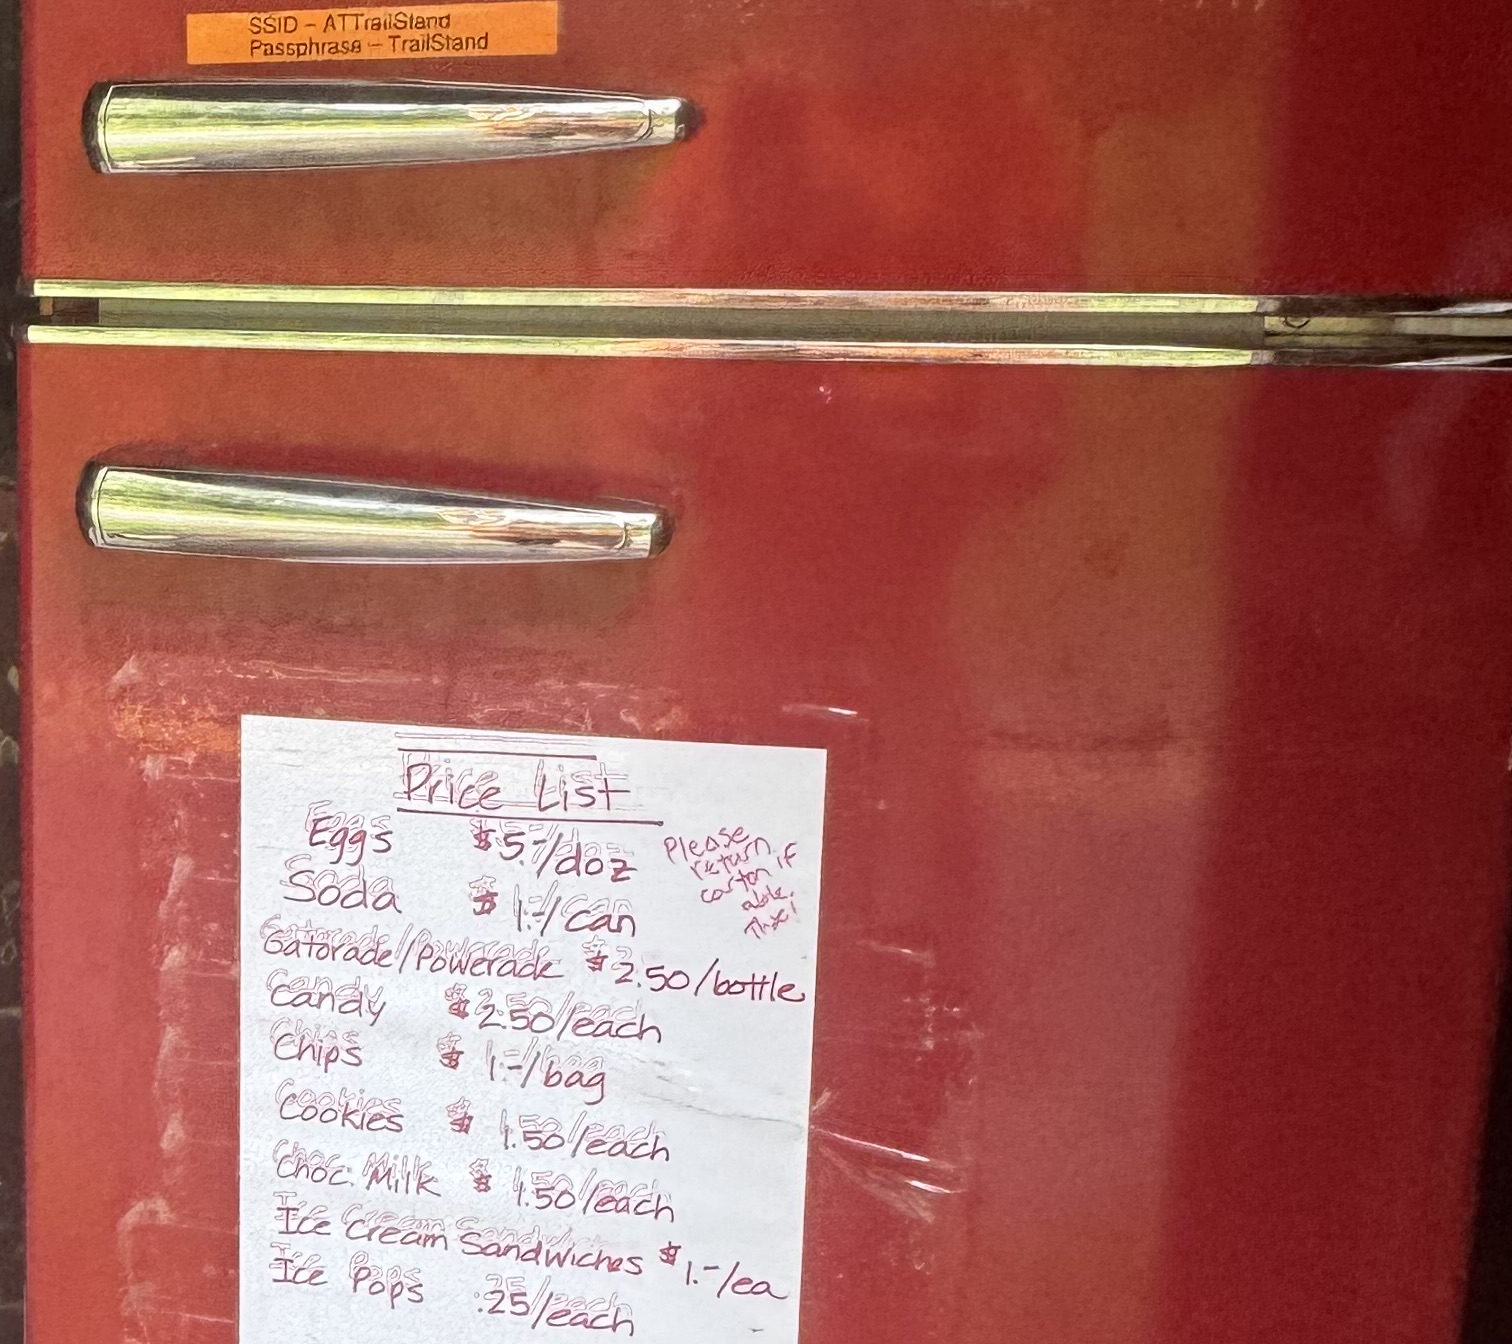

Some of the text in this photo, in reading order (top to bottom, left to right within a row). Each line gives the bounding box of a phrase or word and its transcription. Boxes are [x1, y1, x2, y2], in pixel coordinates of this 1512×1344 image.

[248, 13, 299, 35] SSID
[322, 11, 451, 32] ATTrailStand
[249, 36, 362, 58] Passphrase
[389, 32, 489, 54] TrailStand
[402, 760, 632, 813] Price List
[307, 816, 394, 866] Eggs
[664, 826, 750, 864] Please
[282, 867, 403, 914] Soda
[261, 921, 565, 982] Gatorade/Powerade
[269, 982, 388, 1026] Candy
[272, 1029, 364, 1072] Chips
[278, 1093, 405, 1136] Cookies
[365, 1160, 442, 1199] Milk
[275, 1204, 332, 1238] Ice
[344, 1212, 449, 1253] Cream
[460, 1230, 644, 1277] Sandwiches
[271, 1258, 329, 1288] Ice
[350, 1266, 425, 1310] Pops
